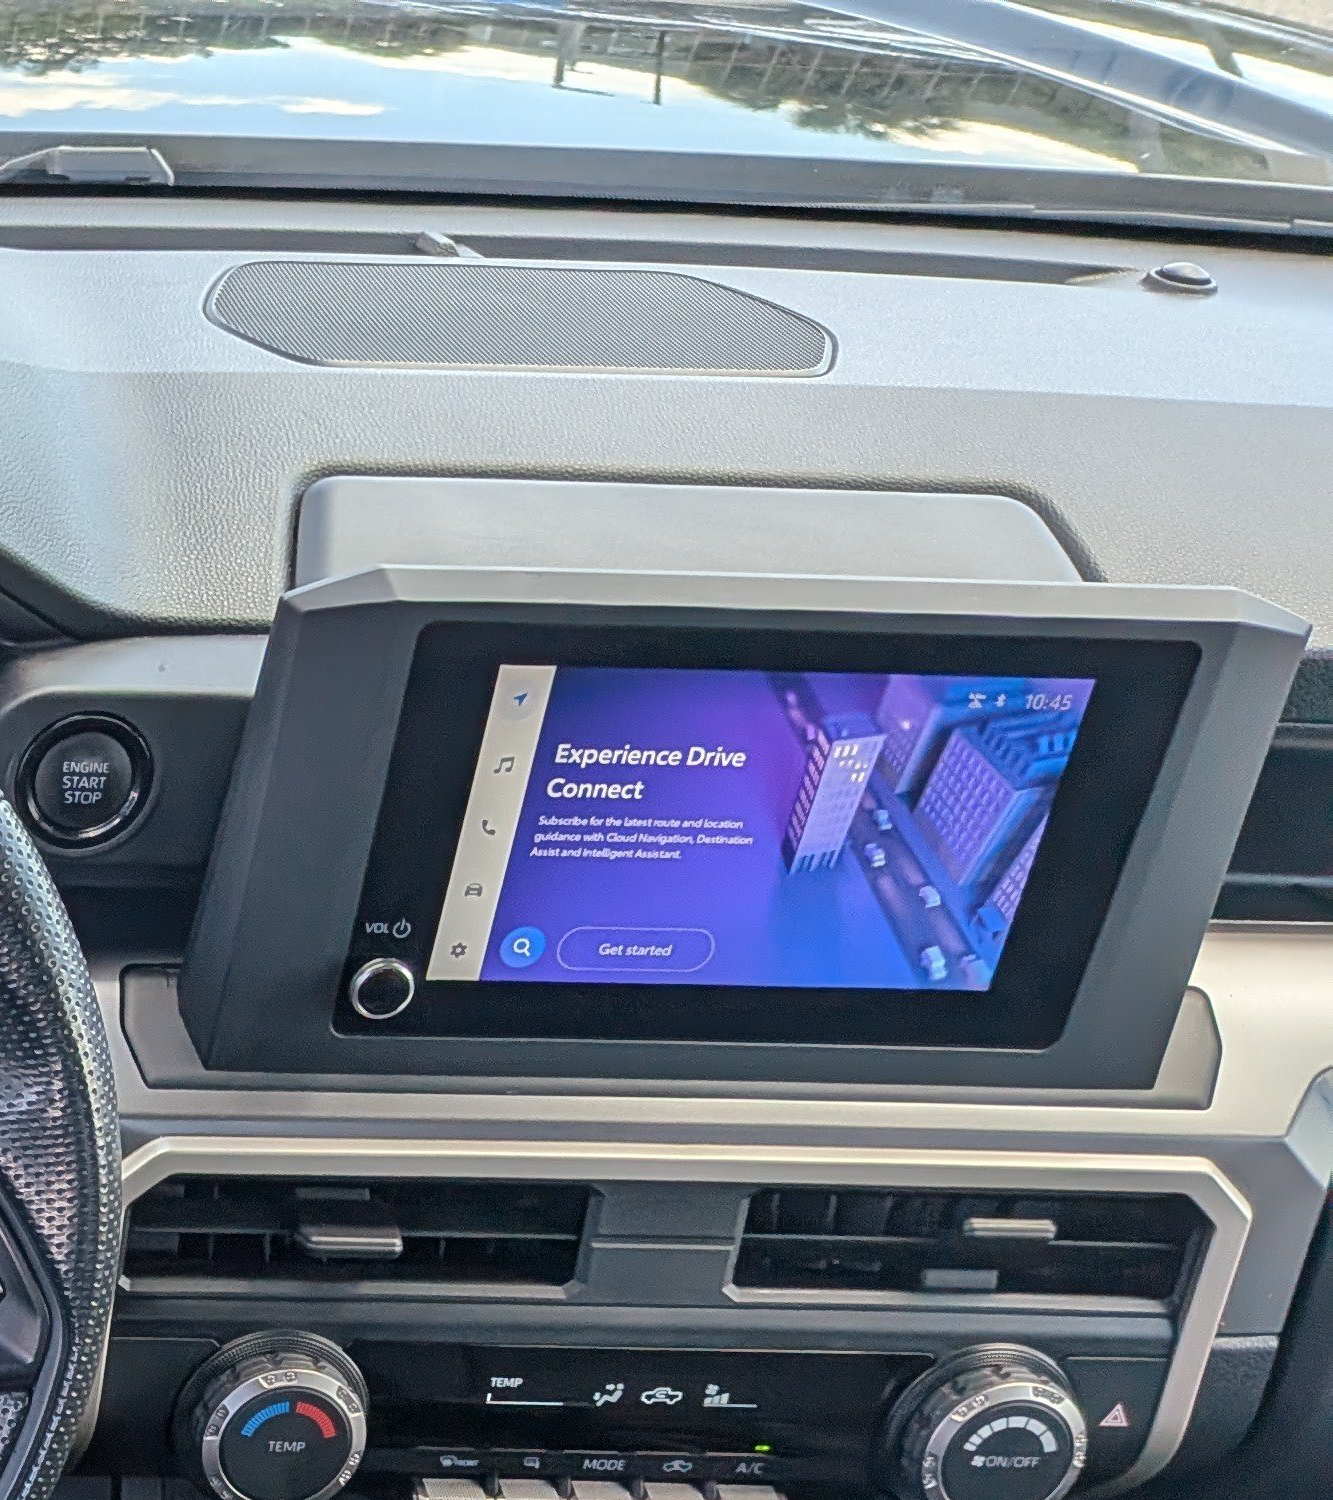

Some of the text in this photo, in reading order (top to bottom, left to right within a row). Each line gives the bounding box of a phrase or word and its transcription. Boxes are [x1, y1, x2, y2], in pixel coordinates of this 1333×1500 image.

[1025, 691, 1074, 714] 10:45
[554, 743, 747, 769] Experience Drive
[62, 761, 110, 774] ENGINE
[62, 776, 107, 789] START
[547, 778, 644, 800] Connect
[64, 790, 102, 804] STOP
[538, 815, 744, 830] Subscribe for the latest route and location
[534, 832, 581, 843] guidance
[582, 833, 604, 843] with
[606, 833, 637, 843] Cloud
[696, 834, 753, 845] Destination
[530, 846, 560, 857] Assist
[561, 847, 581, 858] and
[582, 848, 633, 860] Intelligent
[365, 921, 389, 935] VOL
[598, 940, 673, 960] Get started
[490, 1377, 523, 1389] TEMP
[267, 1440, 307, 1454] TEMP
[582, 1458, 626, 1472] MODE
[735, 1461, 764, 1476] A/C
[986, 1455, 1040, 1468] ON/OFF
